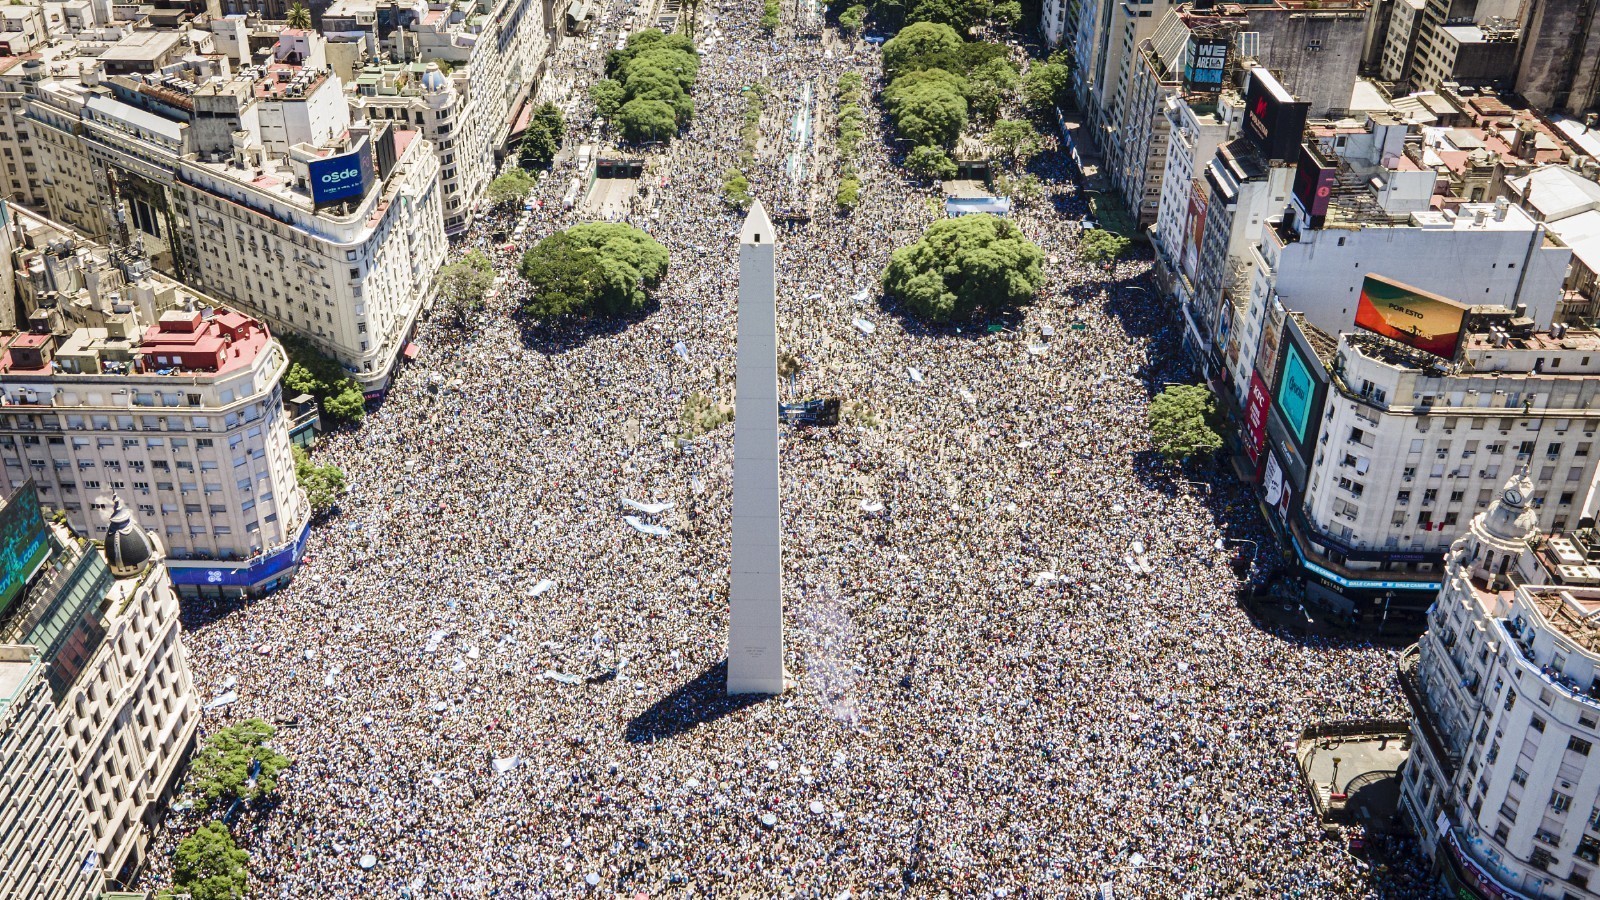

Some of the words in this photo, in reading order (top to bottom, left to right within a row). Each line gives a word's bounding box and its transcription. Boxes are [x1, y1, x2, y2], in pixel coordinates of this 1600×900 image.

[1199, 44, 1227, 57] WE
[1196, 56, 1209, 68] ARE
[322, 168, 358, 183] osde
[1388, 303, 1405, 313] POR
[1405, 309, 1423, 319] ESTO
[1253, 385, 1265, 408] KFC
